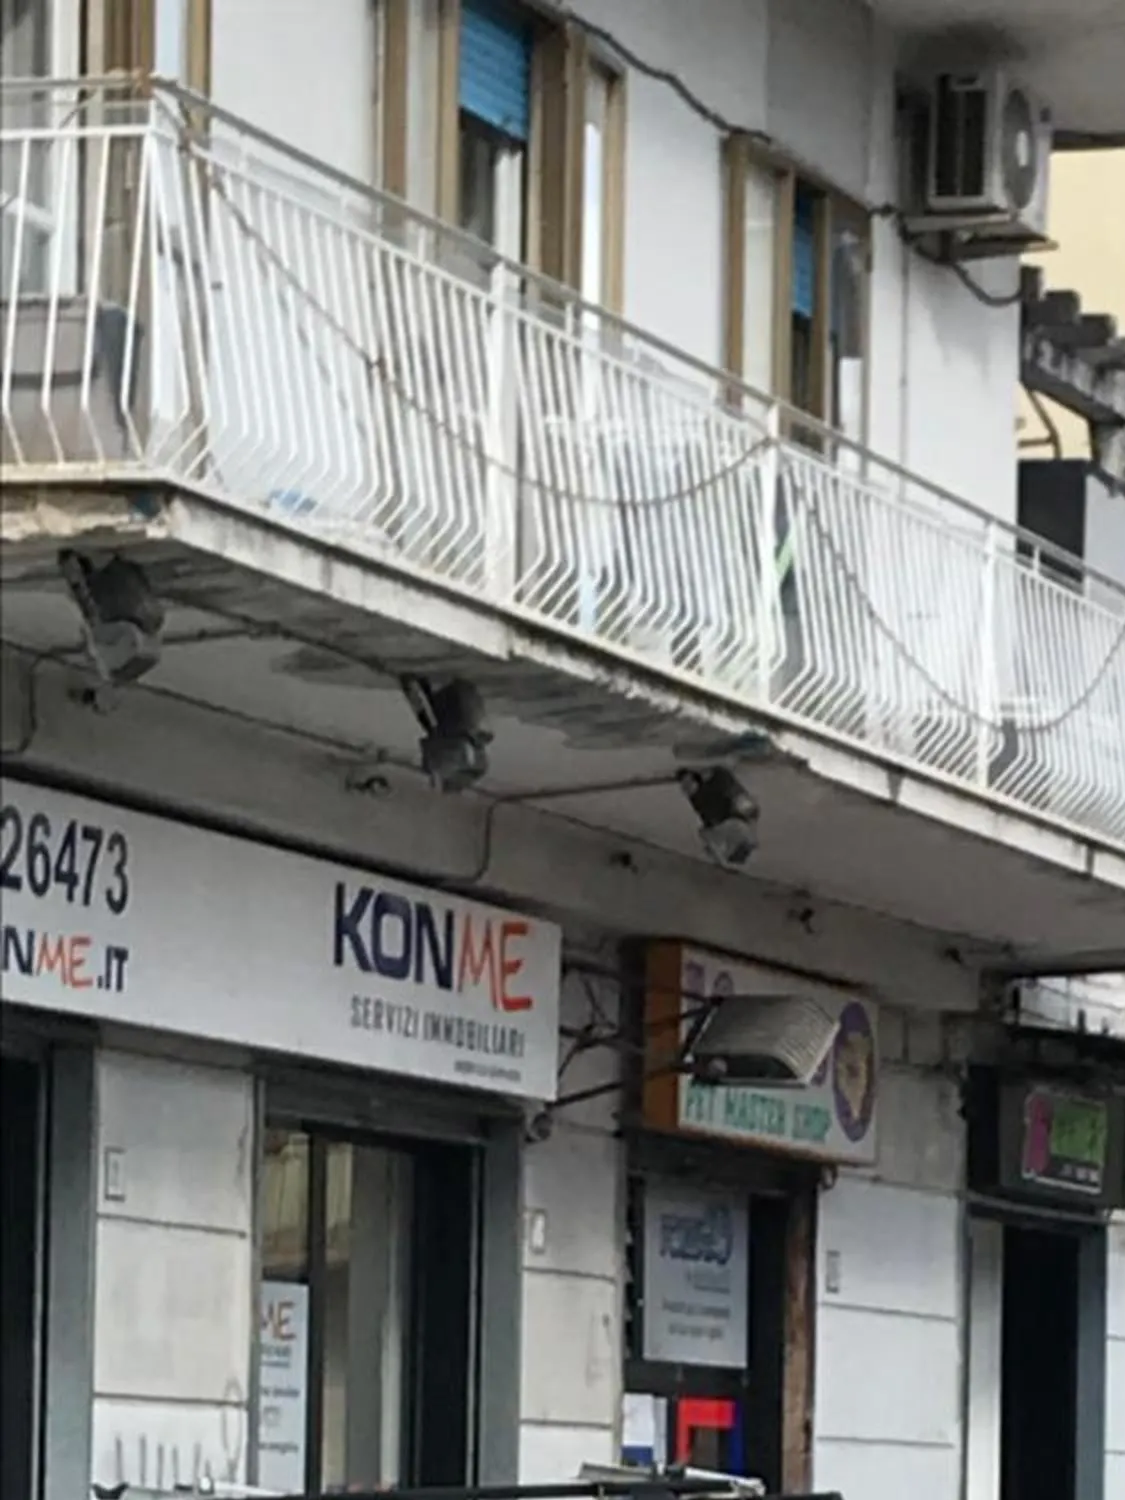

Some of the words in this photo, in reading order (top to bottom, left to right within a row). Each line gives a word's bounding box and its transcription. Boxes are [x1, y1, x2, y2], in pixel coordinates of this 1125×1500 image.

[0, 805, 129, 915] 26473
[333, 881, 533, 1011] KONME
[350, 995, 420, 1038] SERVIZI
